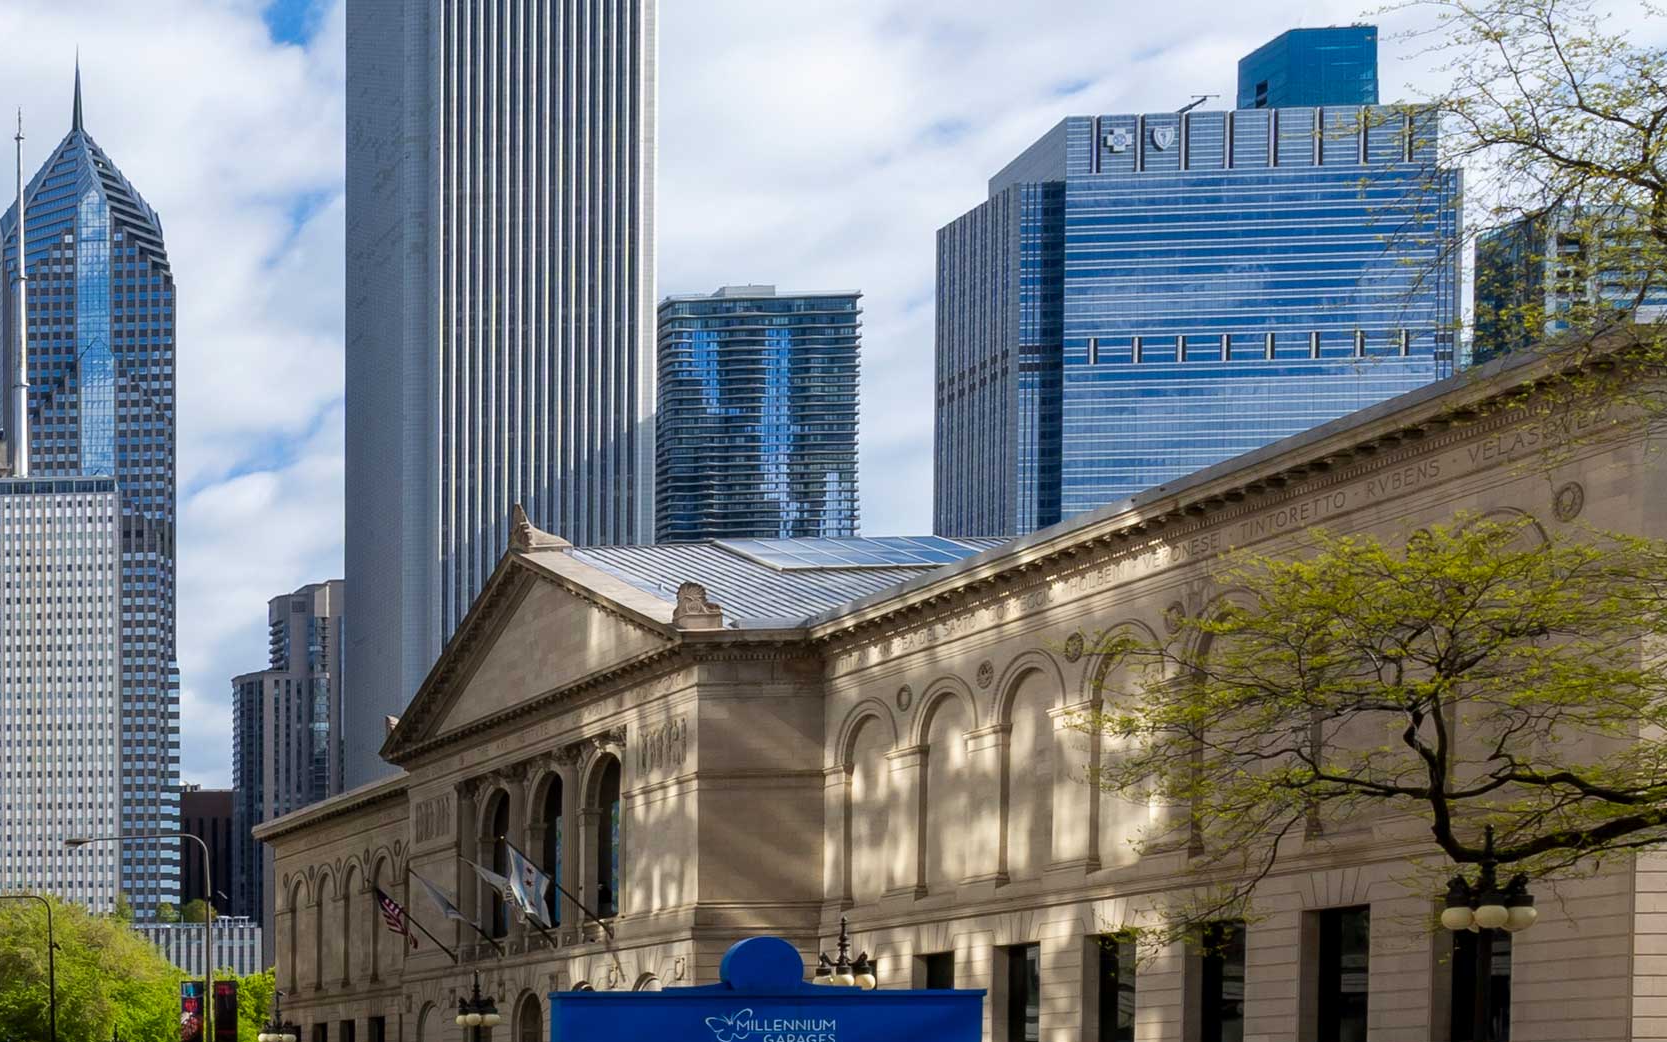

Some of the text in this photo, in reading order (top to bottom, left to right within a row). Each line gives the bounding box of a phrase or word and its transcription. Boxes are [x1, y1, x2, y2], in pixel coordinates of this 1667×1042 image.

[1240, 458, 1440, 540] TINTORETTO RVBENS
[736, 1019, 836, 1032] MILLENNIUM
